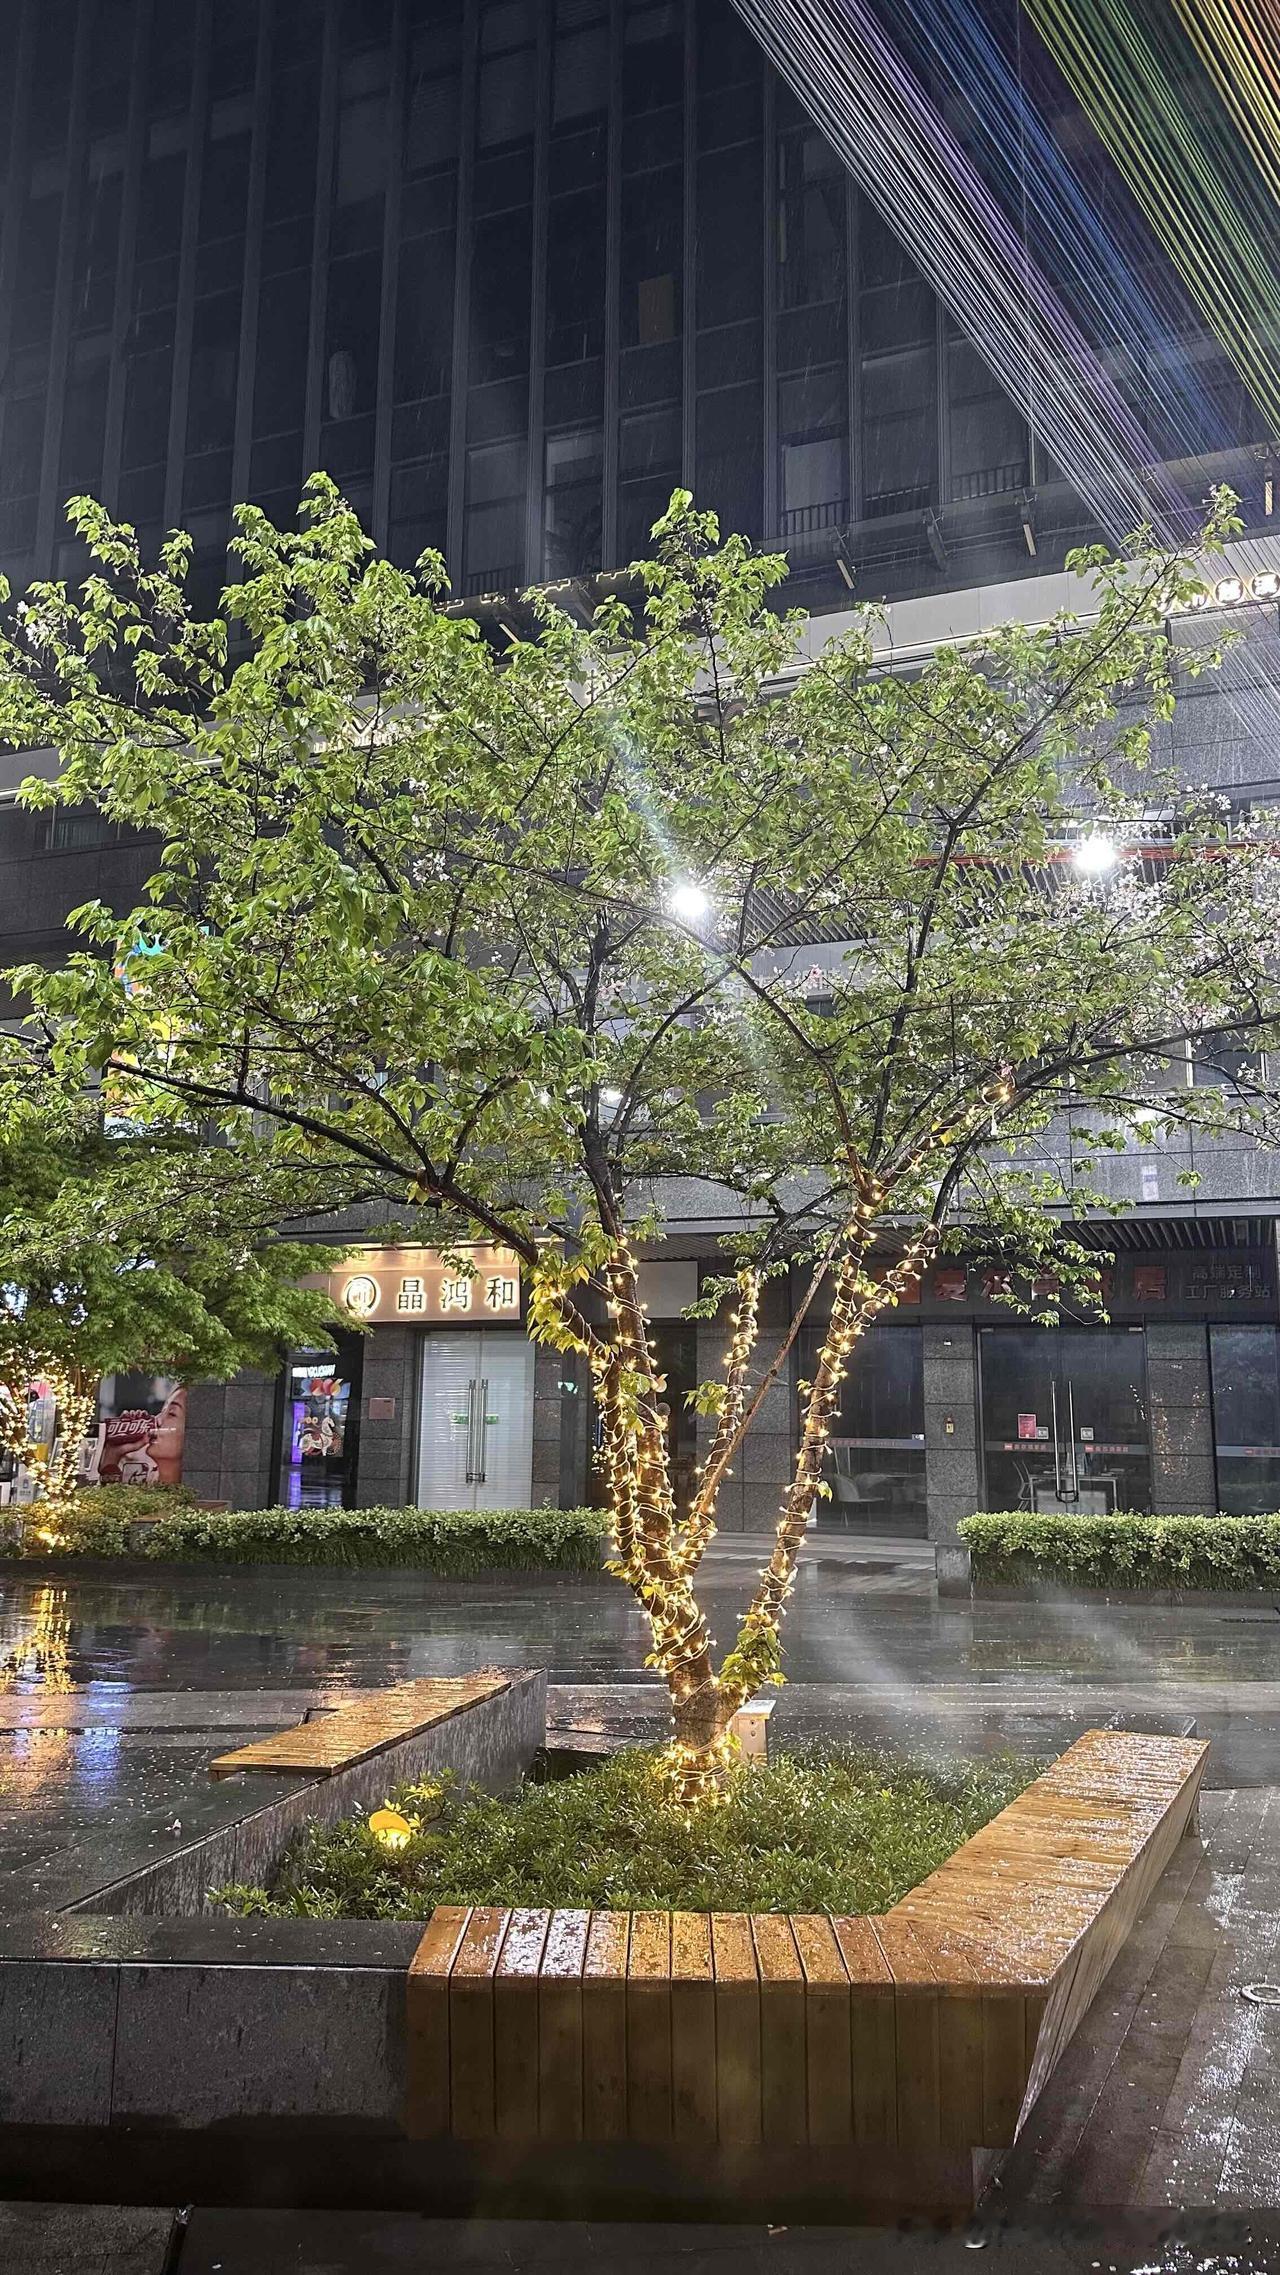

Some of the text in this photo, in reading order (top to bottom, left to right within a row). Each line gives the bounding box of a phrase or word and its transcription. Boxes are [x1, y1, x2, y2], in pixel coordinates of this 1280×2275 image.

[398, 1277, 514, 1310] 晶鸿和
[1185, 1284, 1272, 1301] 工厂服务站
[107, 1418, 152, 1437] 可口可乐
